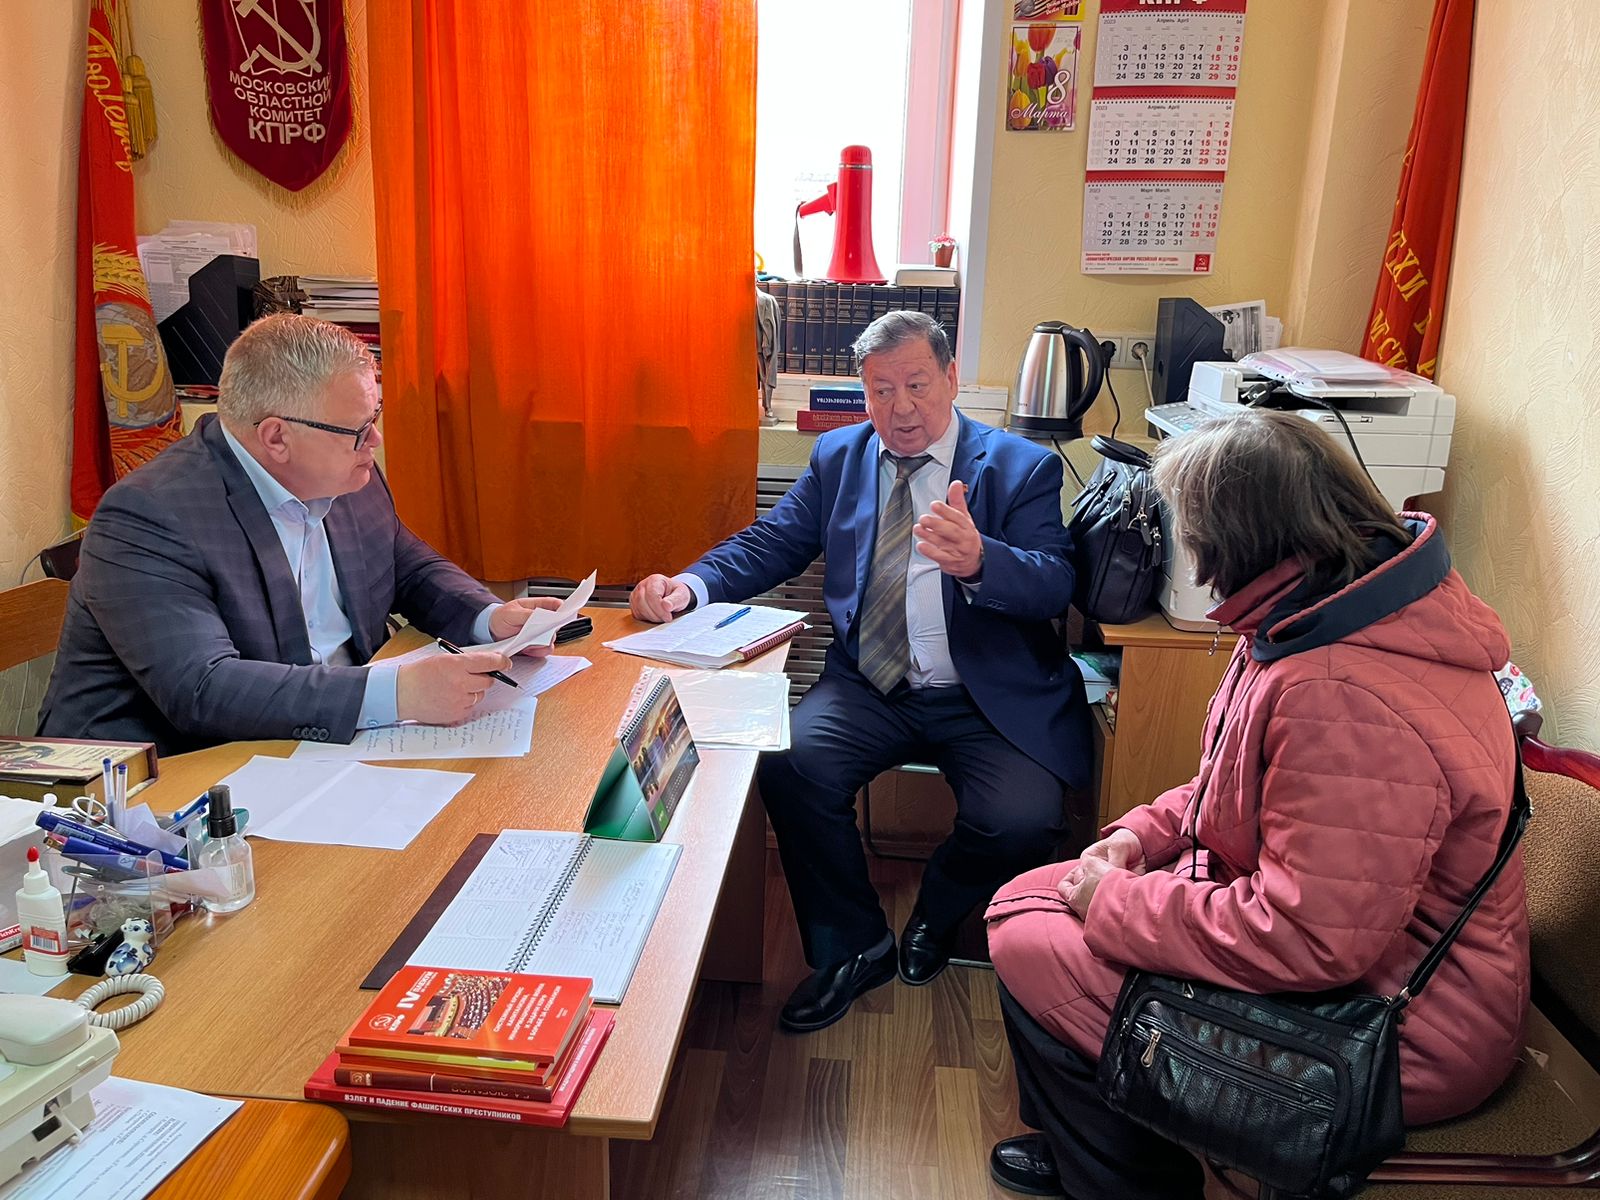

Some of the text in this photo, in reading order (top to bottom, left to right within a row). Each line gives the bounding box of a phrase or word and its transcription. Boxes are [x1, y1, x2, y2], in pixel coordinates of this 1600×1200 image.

[1047, 70, 1070, 104] 8
[250, 105, 322, 122] КОМИТЕТ
[1011, 103, 1068, 123] Марта
[248, 118, 326, 144] КПРФ
[397, 991, 420, 1008] IV
[344, 1094, 367, 1102] ВЗЛЕТ
[376, 1098, 409, 1108] ПАДЕНИЕ
[411, 1102, 462, 1114] ФАШИСТСКИХ
[464, 1109, 521, 1120] ПРЕСТУПНИКОВ
